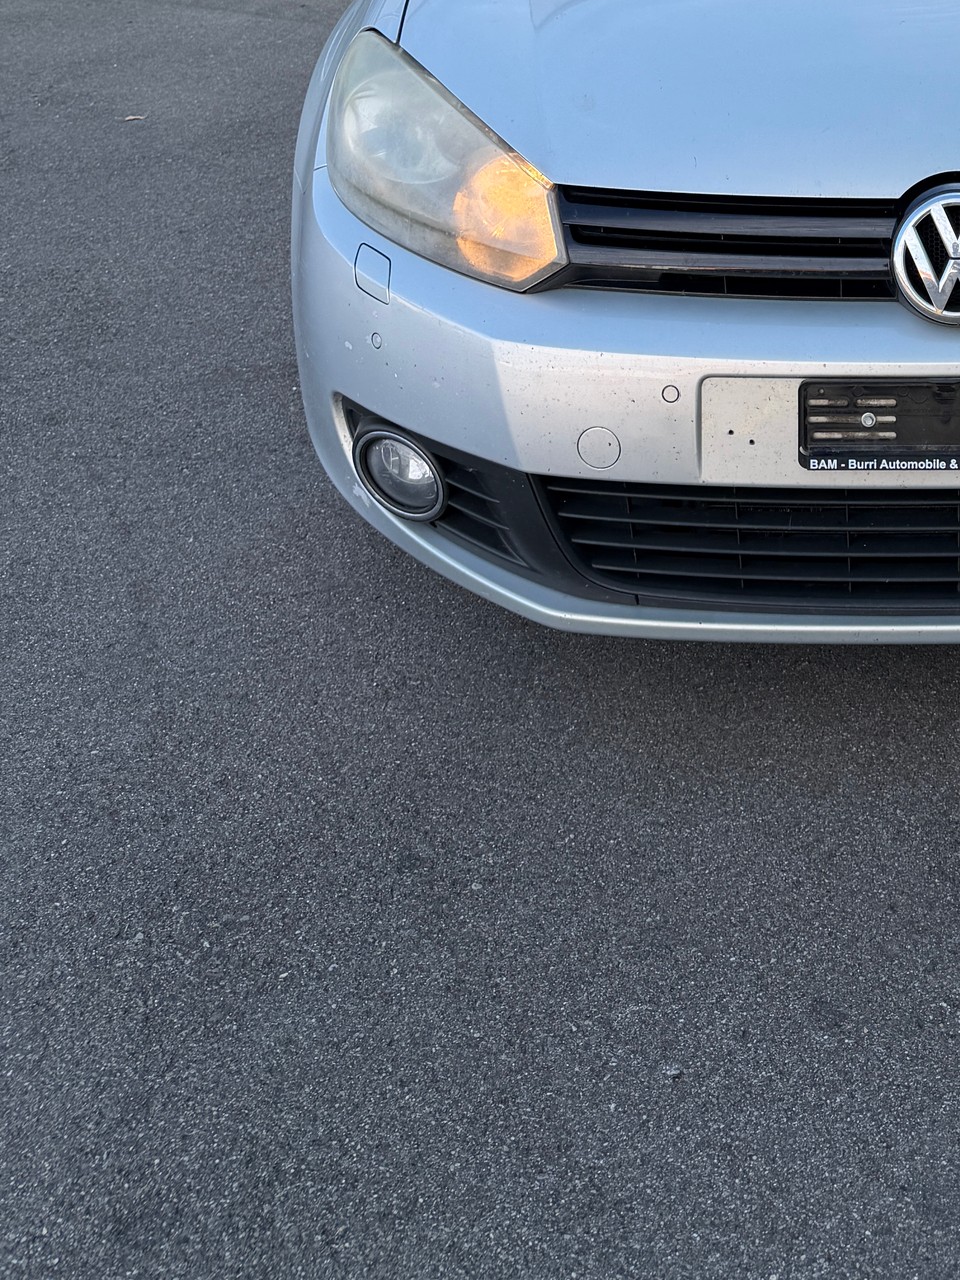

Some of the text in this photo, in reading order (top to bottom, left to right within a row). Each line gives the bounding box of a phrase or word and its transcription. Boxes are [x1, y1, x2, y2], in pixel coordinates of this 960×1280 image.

[809, 459, 837, 469] BAM
[848, 459, 877, 469] Burri
[880, 459, 946, 469] Automobile
[949, 459, 959, 469] &
